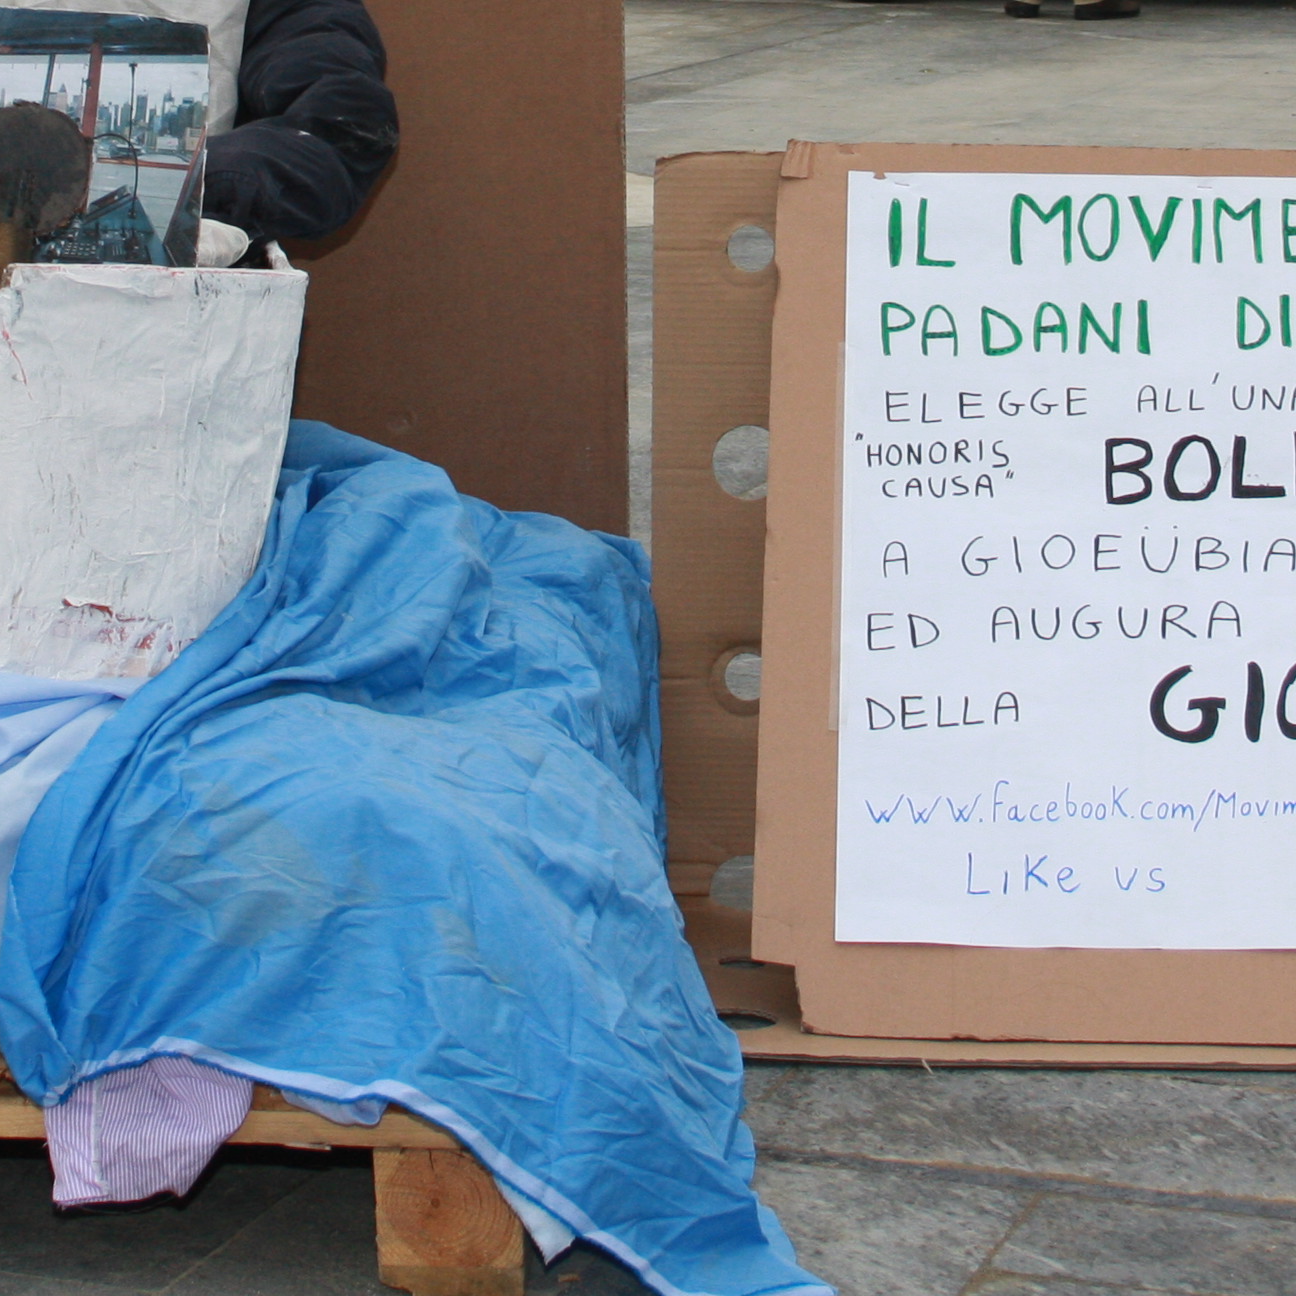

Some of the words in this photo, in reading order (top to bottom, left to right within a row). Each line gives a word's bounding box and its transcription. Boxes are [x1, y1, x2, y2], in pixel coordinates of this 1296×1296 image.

[888, 196, 956, 268] IL
[880, 299, 1151, 357] PADANI
[1237, 295, 1292, 350] DI
[885, 387, 1088, 423] ELEGGE
[883, 540, 908, 578] A
[961, 525, 1296, 577] GIOEÜBIA
[867, 612, 940, 651] ED
[991, 600, 1242, 643] AUGURA
[865, 691, 1019, 730] DELLA
